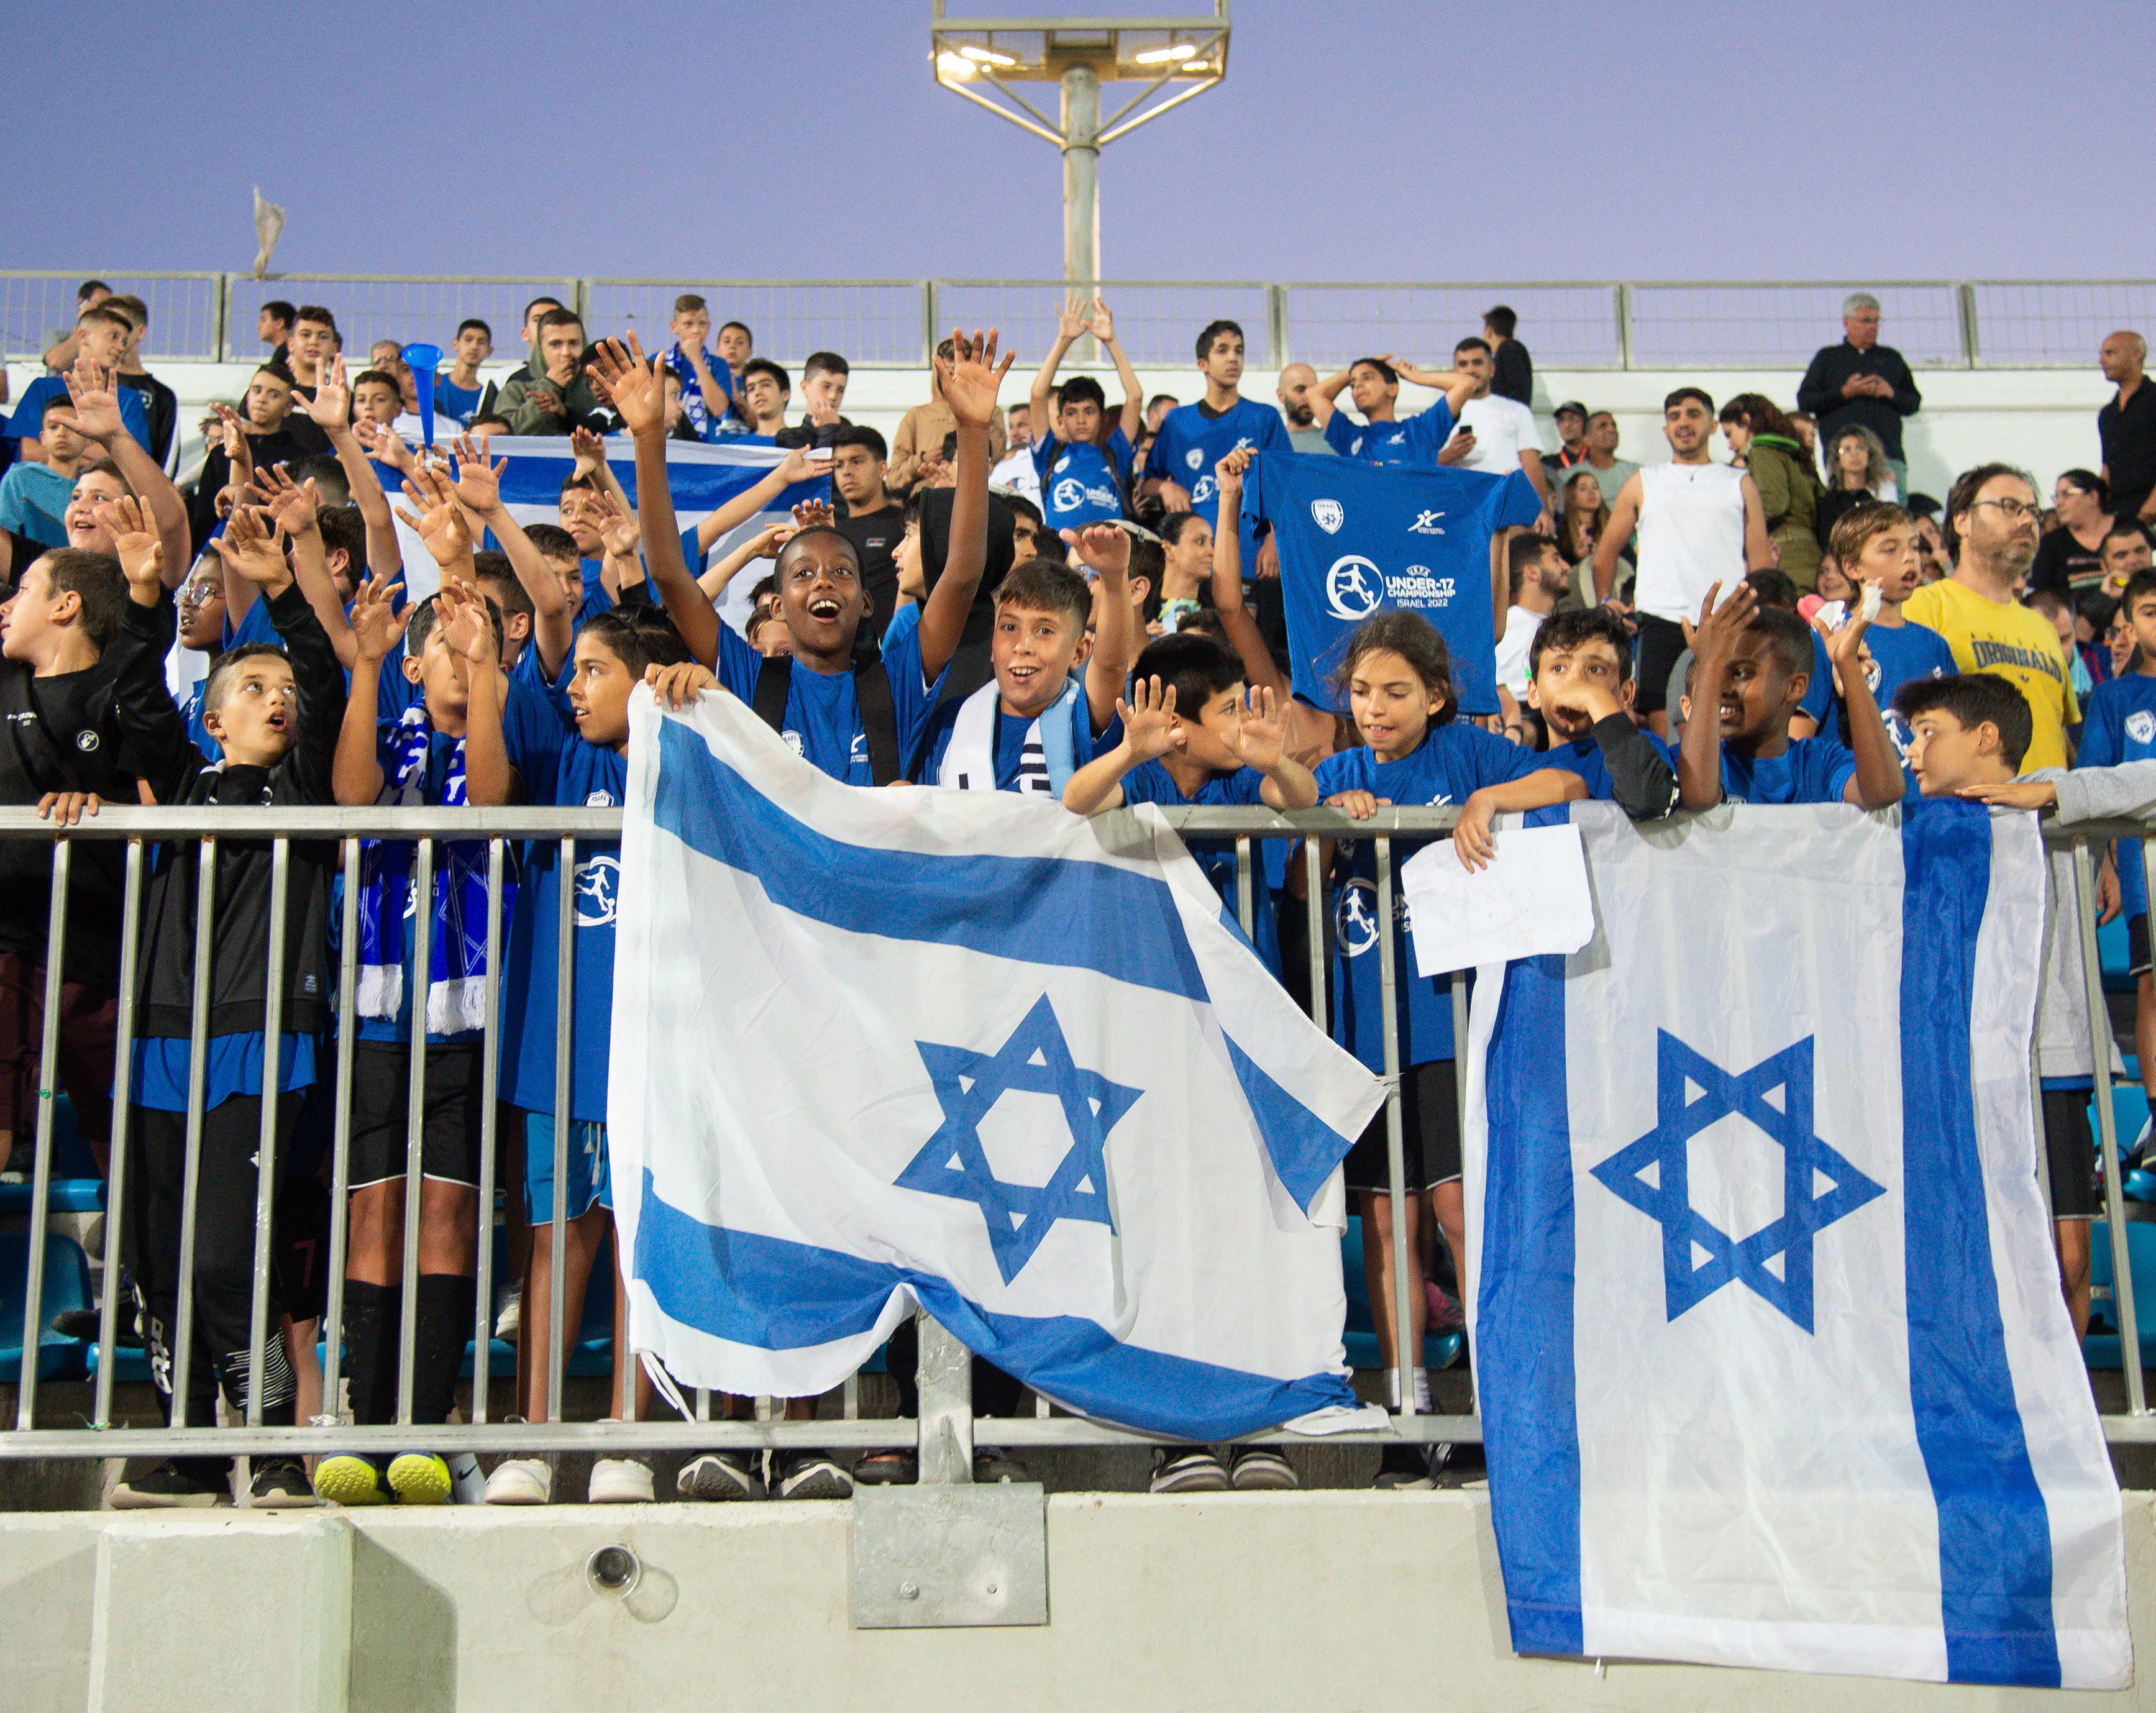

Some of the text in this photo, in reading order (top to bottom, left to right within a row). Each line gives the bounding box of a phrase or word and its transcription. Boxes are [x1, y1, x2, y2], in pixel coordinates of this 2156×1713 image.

[1386, 576, 1455, 590] UNDER-17
[1387, 588, 1456, 598] CHAMPIONSHIP
[1397, 598, 1448, 608] ISRAEL 2022
[1972, 640, 2062, 683] ORIGINALS
